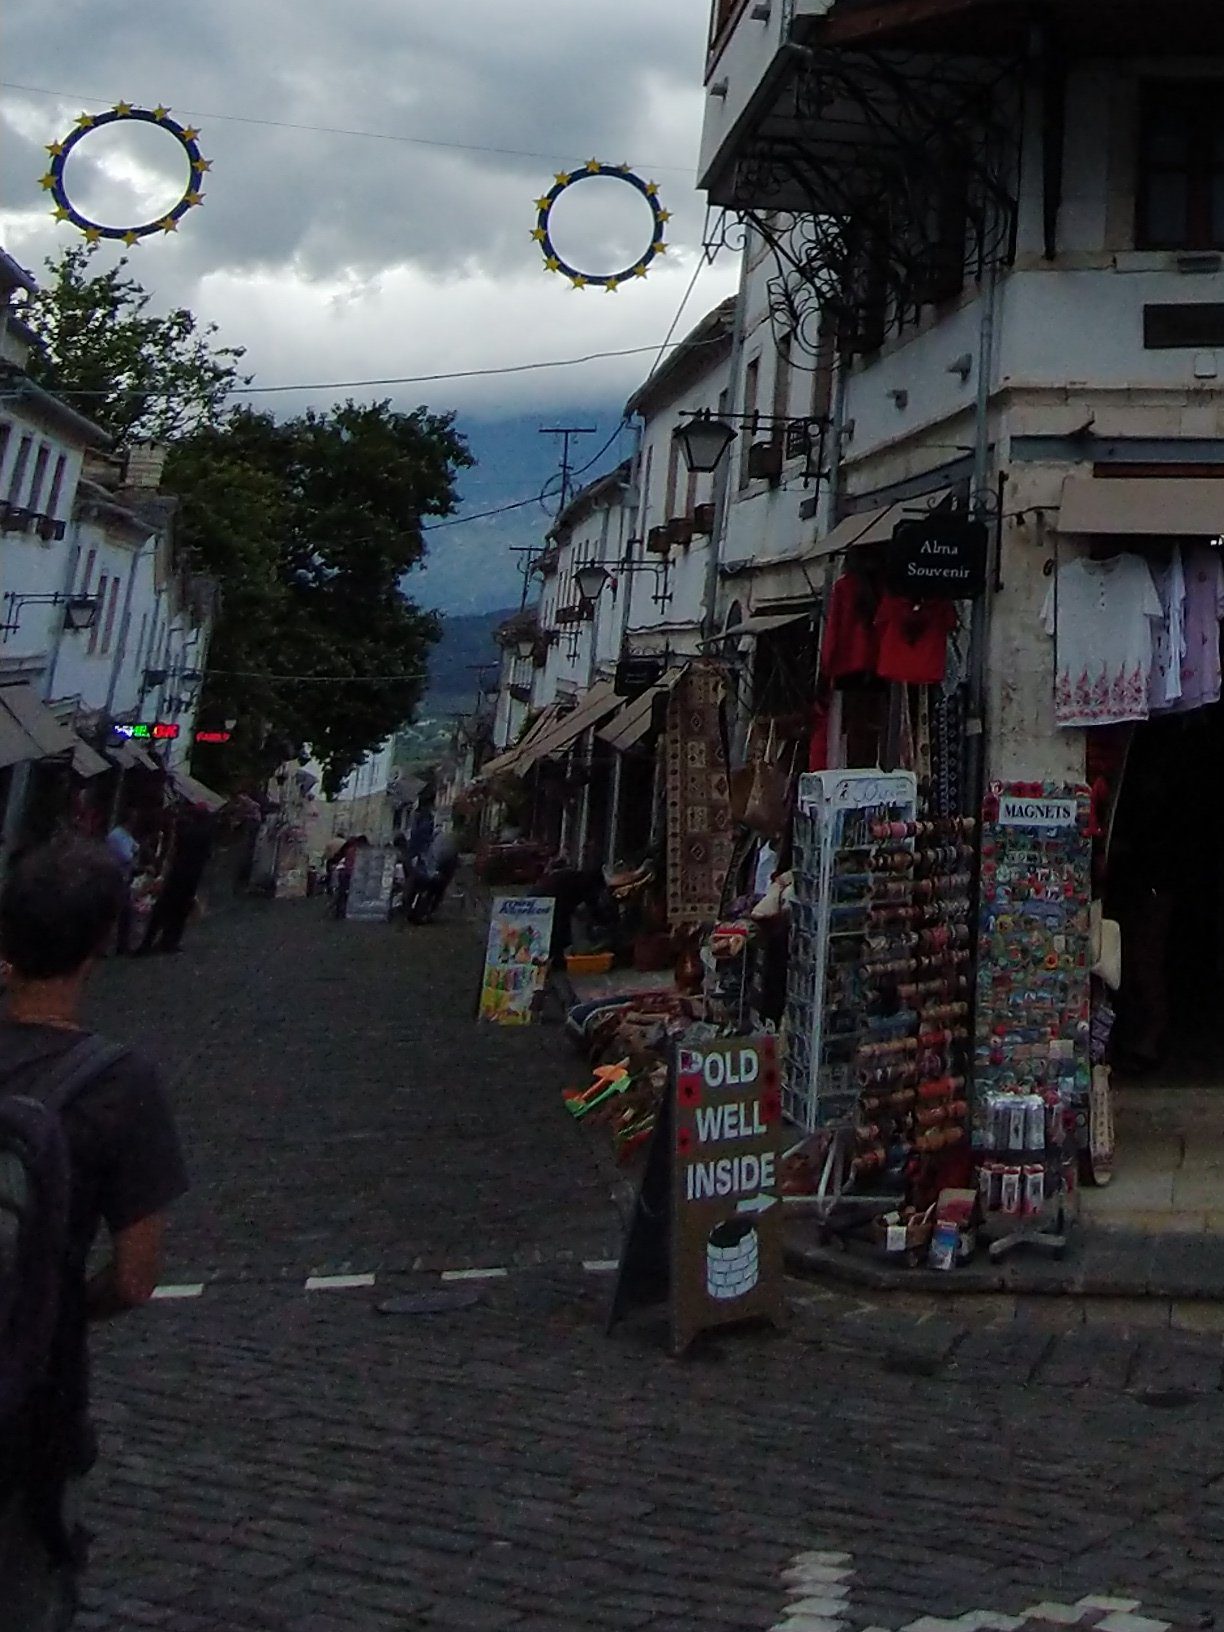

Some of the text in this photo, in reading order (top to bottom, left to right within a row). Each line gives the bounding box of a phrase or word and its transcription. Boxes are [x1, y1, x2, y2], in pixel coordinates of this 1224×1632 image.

[920, 539, 958, 555] Alma
[907, 562, 970, 578] Souvenir
[1004, 804, 1071, 819] MAGNETS
[703, 1048, 759, 1087] OLD
[695, 1100, 767, 1143] WELL
[687, 1152, 775, 1201] INSIDE
